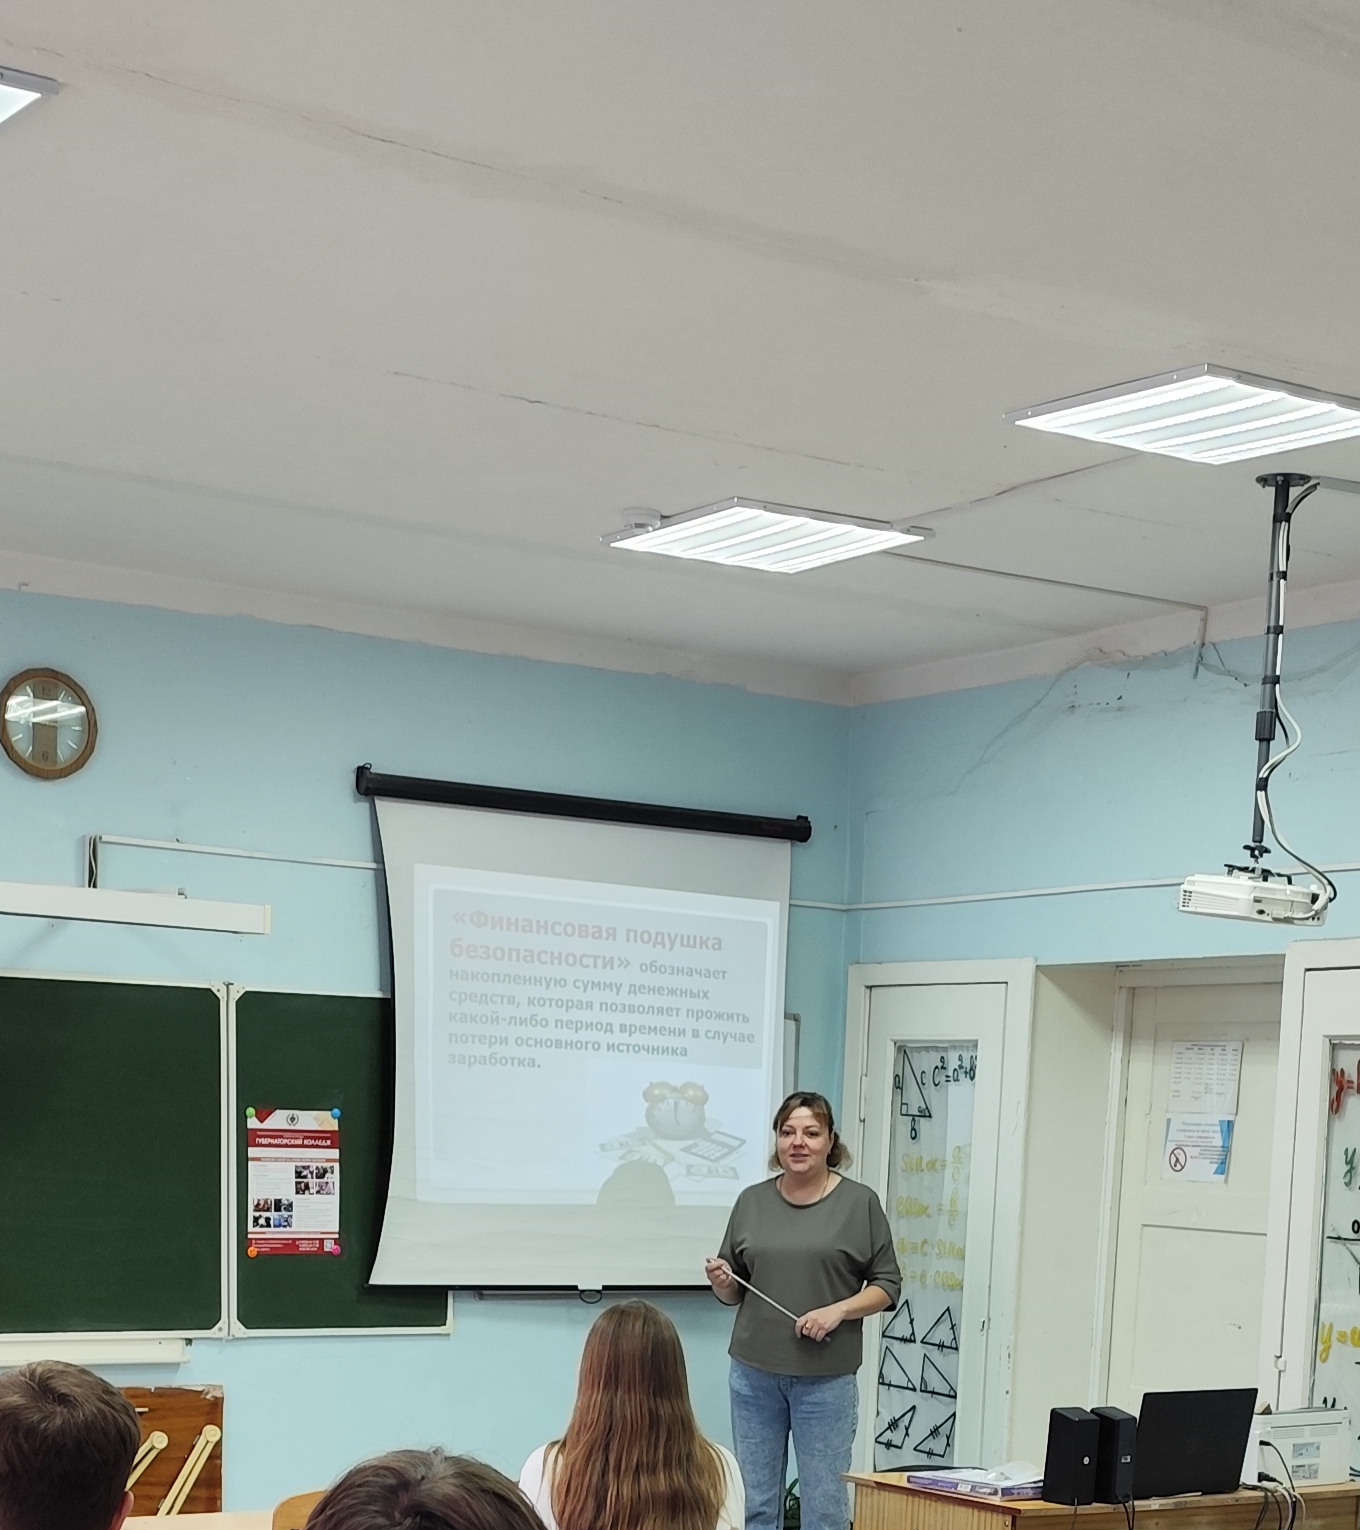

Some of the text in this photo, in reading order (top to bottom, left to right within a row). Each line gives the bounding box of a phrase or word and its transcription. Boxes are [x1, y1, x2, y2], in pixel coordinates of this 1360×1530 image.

[452, 909, 722, 951] «Финансовая подушка
[449, 937, 727, 980] безопасности» обозначает
[449, 969, 710, 1000] накопленную сумму денежных
[448, 990, 750, 1024] средств, которая позволяет прожить
[448, 1010, 755, 1044] какой-либо период времени в случае
[447, 1052, 541, 1069] заработка.
[448, 1032, 688, 1057] потери основного источника
